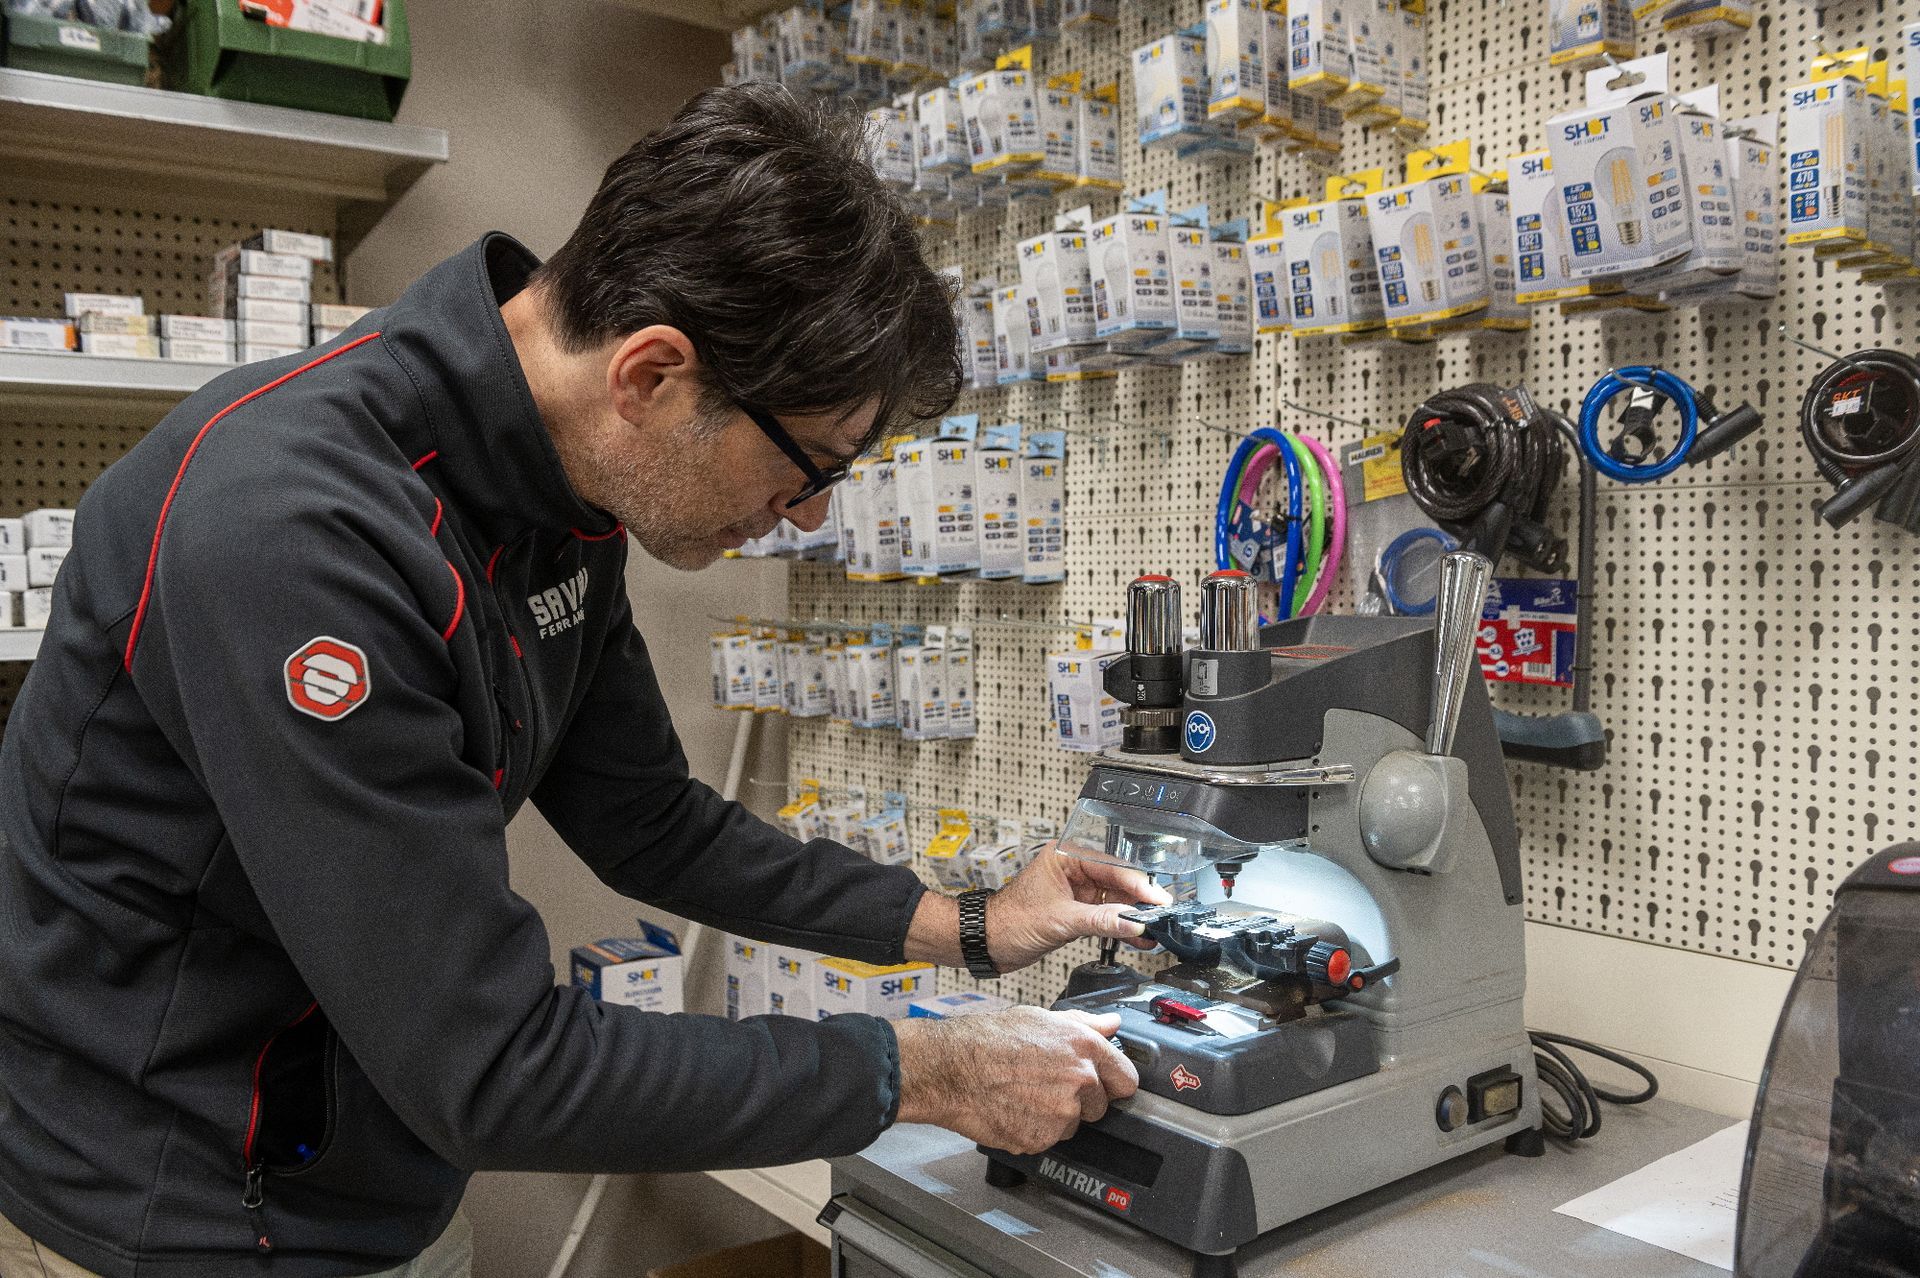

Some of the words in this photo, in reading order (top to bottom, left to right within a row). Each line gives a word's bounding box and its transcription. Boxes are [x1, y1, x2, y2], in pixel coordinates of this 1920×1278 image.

[1793, 84, 1837, 107] SHOT
[1640, 101, 1664, 123] SHOT
[1564, 116, 1611, 141] SHOT
[1690, 121, 1714, 137] SHOT
[1522, 156, 1553, 175] SHO
[1796, 170, 1814, 184] 470
[1438, 179, 1462, 196] SHOT
[1378, 190, 1413, 210] SHOT
[1293, 209, 1324, 227] SHOT
[1348, 205, 1369, 218] SHO
[1571, 203, 1593, 219] 1521
[1092, 223, 1116, 242] SHOT
[1132, 219, 1159, 232] SHOT
[1060, 236, 1087, 250] SHOT
[1178, 231, 1203, 246] SHOT
[1255, 242, 1283, 255] SHOT
[1832, 387, 1864, 404] SKT
[900, 451, 922, 464] SHOT
[938, 448, 967, 462] SHOT
[985, 456, 1013, 470] SHOT
[878, 468, 897, 480] SHO
[1030, 465, 1058, 477] SHOT
[1057, 662, 1082, 674] SHOT
[777, 956, 802, 975] SHOT
[627, 966, 659, 984] SHOT
[824, 972, 853, 992] SHOT
[880, 975, 921, 996] SHOT
[1040, 1157, 1106, 1200] MATRIX
[1107, 1191, 1127, 1206] pro
